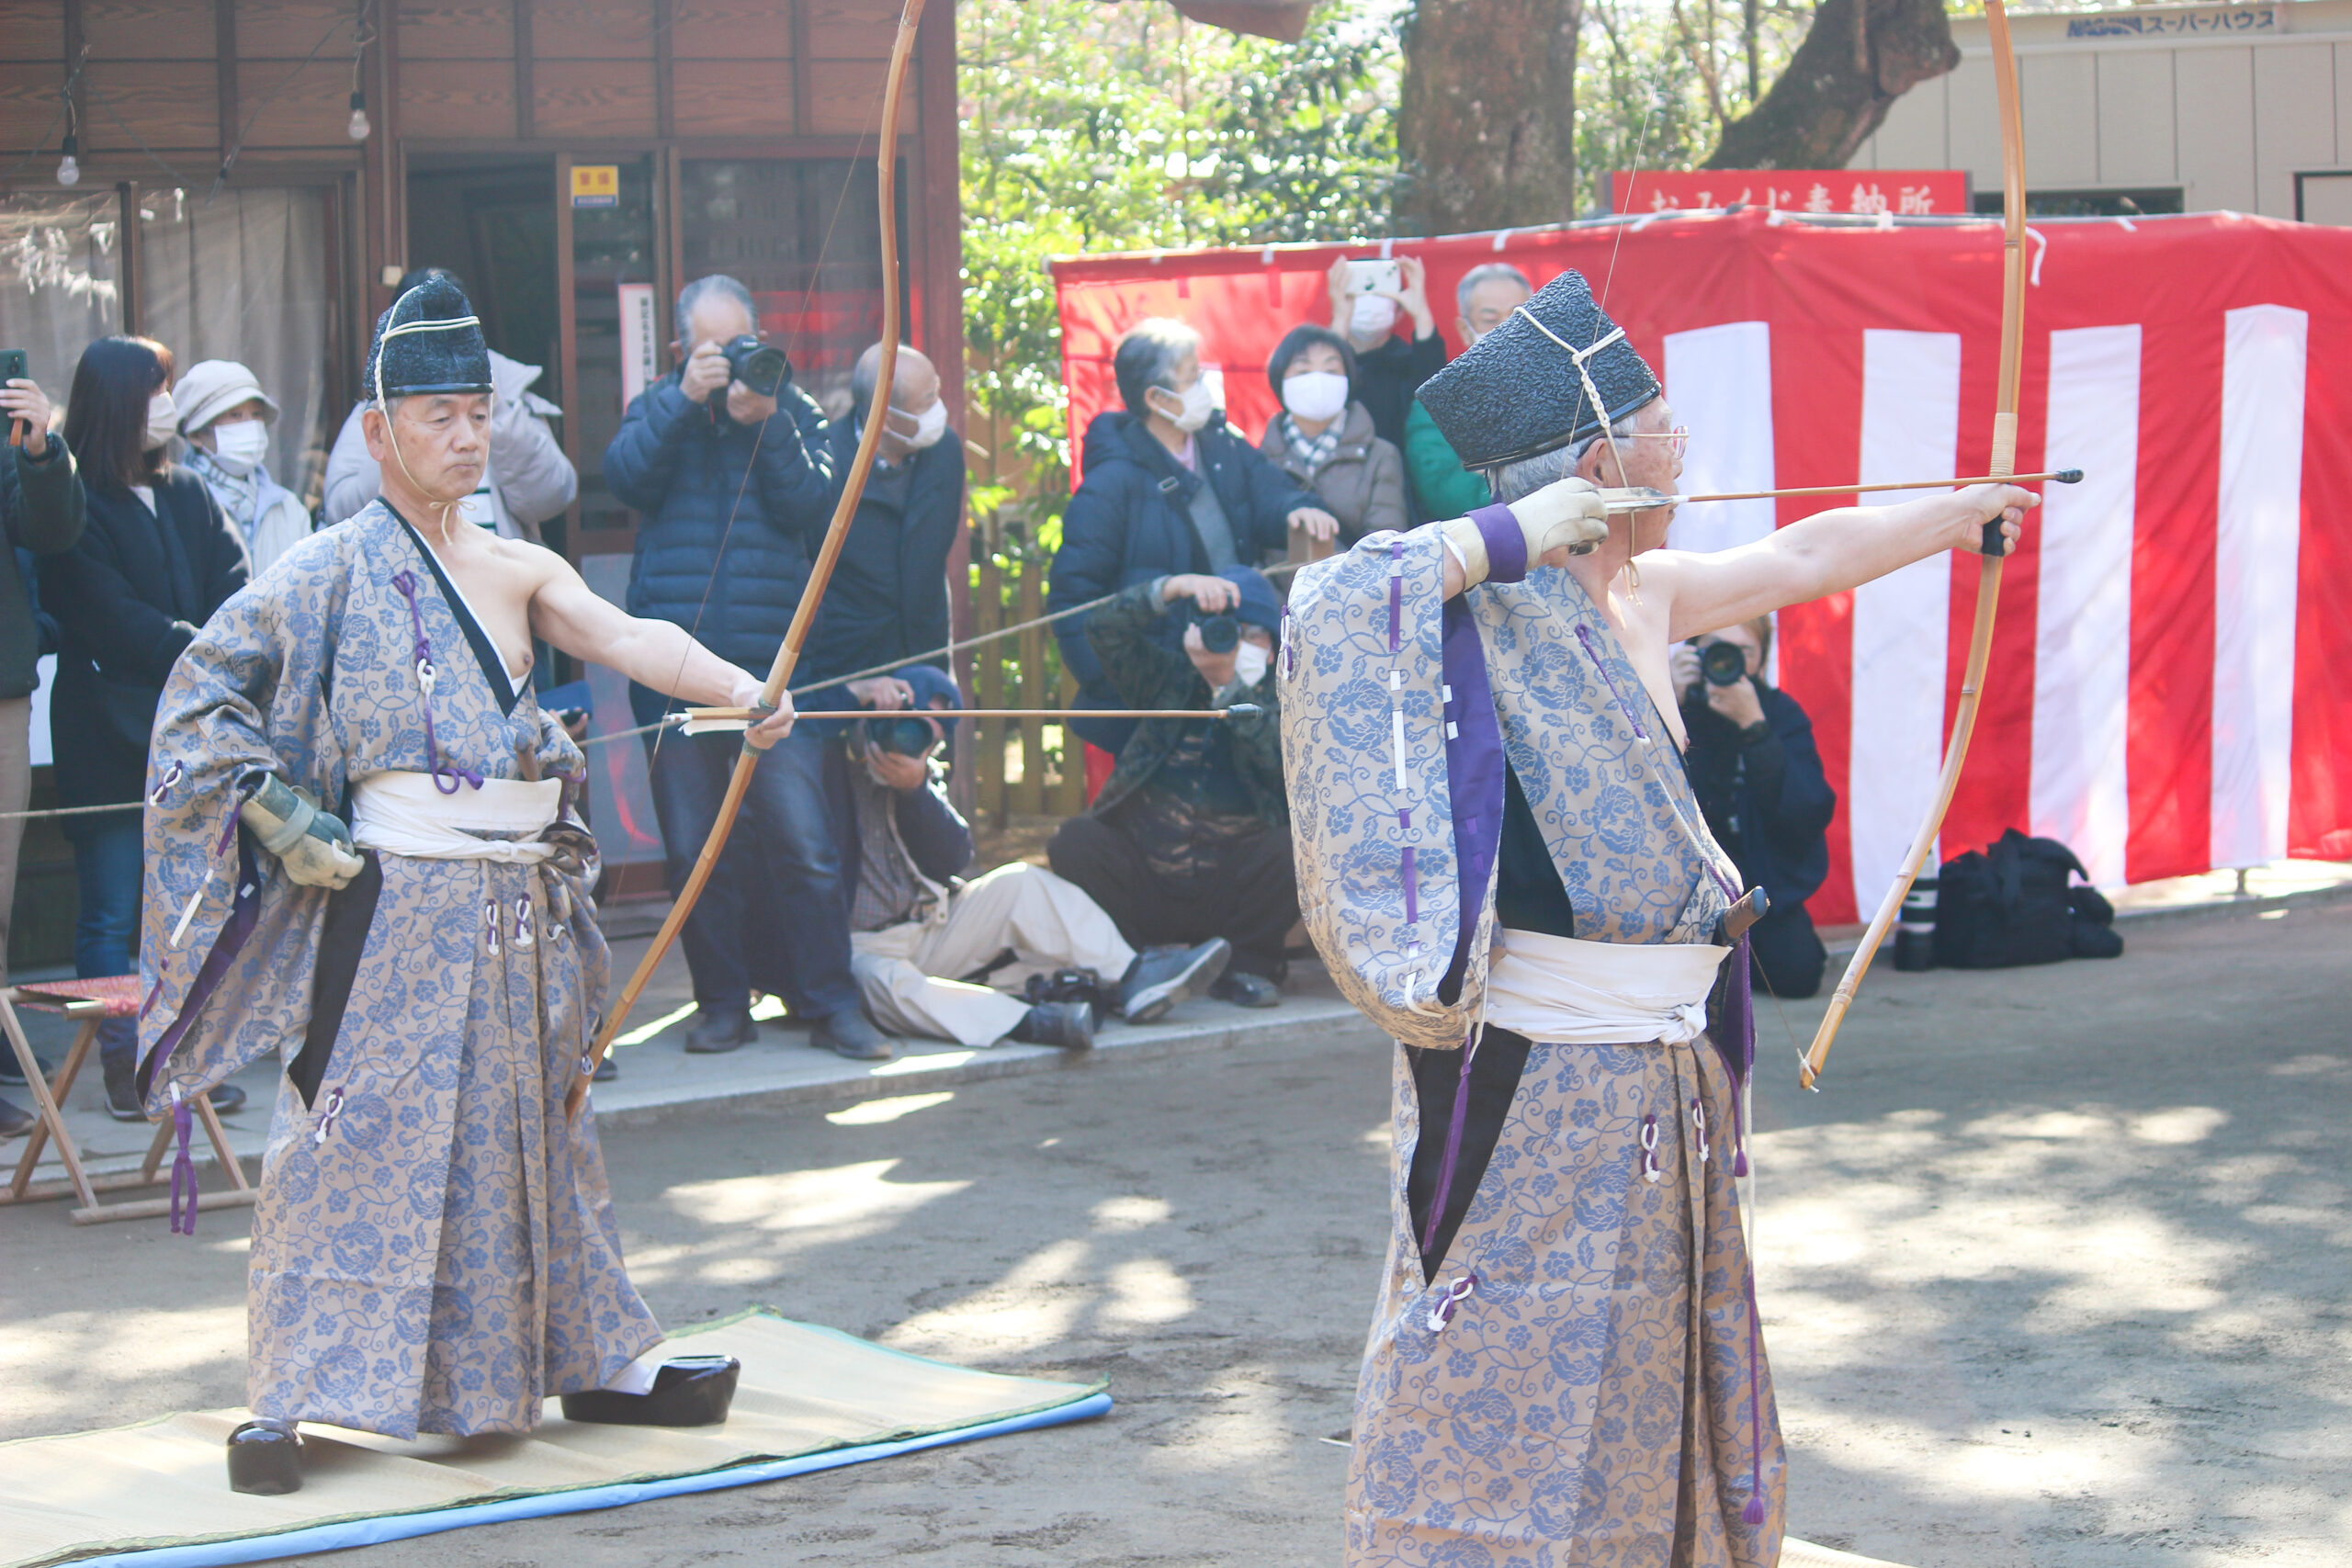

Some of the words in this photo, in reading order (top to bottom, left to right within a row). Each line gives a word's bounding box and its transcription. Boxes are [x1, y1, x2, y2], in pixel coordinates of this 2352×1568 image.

[2145, 10, 2274, 34] スーパーハウス
